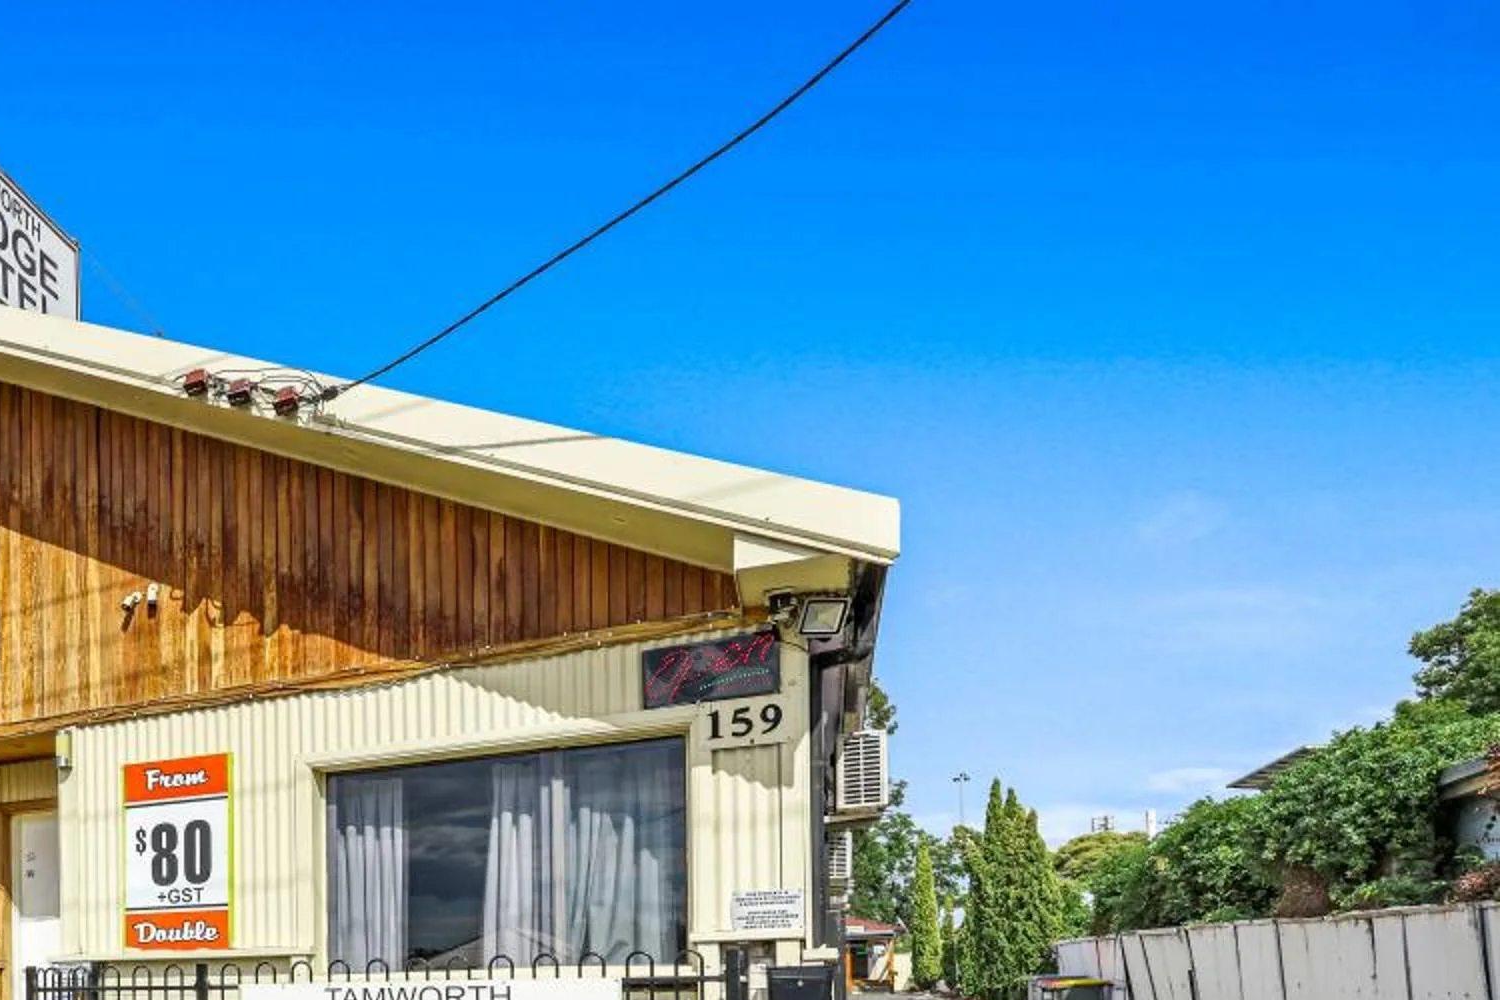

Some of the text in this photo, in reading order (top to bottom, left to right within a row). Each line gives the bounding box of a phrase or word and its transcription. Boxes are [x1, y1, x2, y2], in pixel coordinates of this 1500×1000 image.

[707, 703, 783, 741] 159
[146, 769, 208, 791] From
[135, 819, 212, 886] $80
[157, 887, 204, 904] +GST
[134, 921, 219, 942] Double
